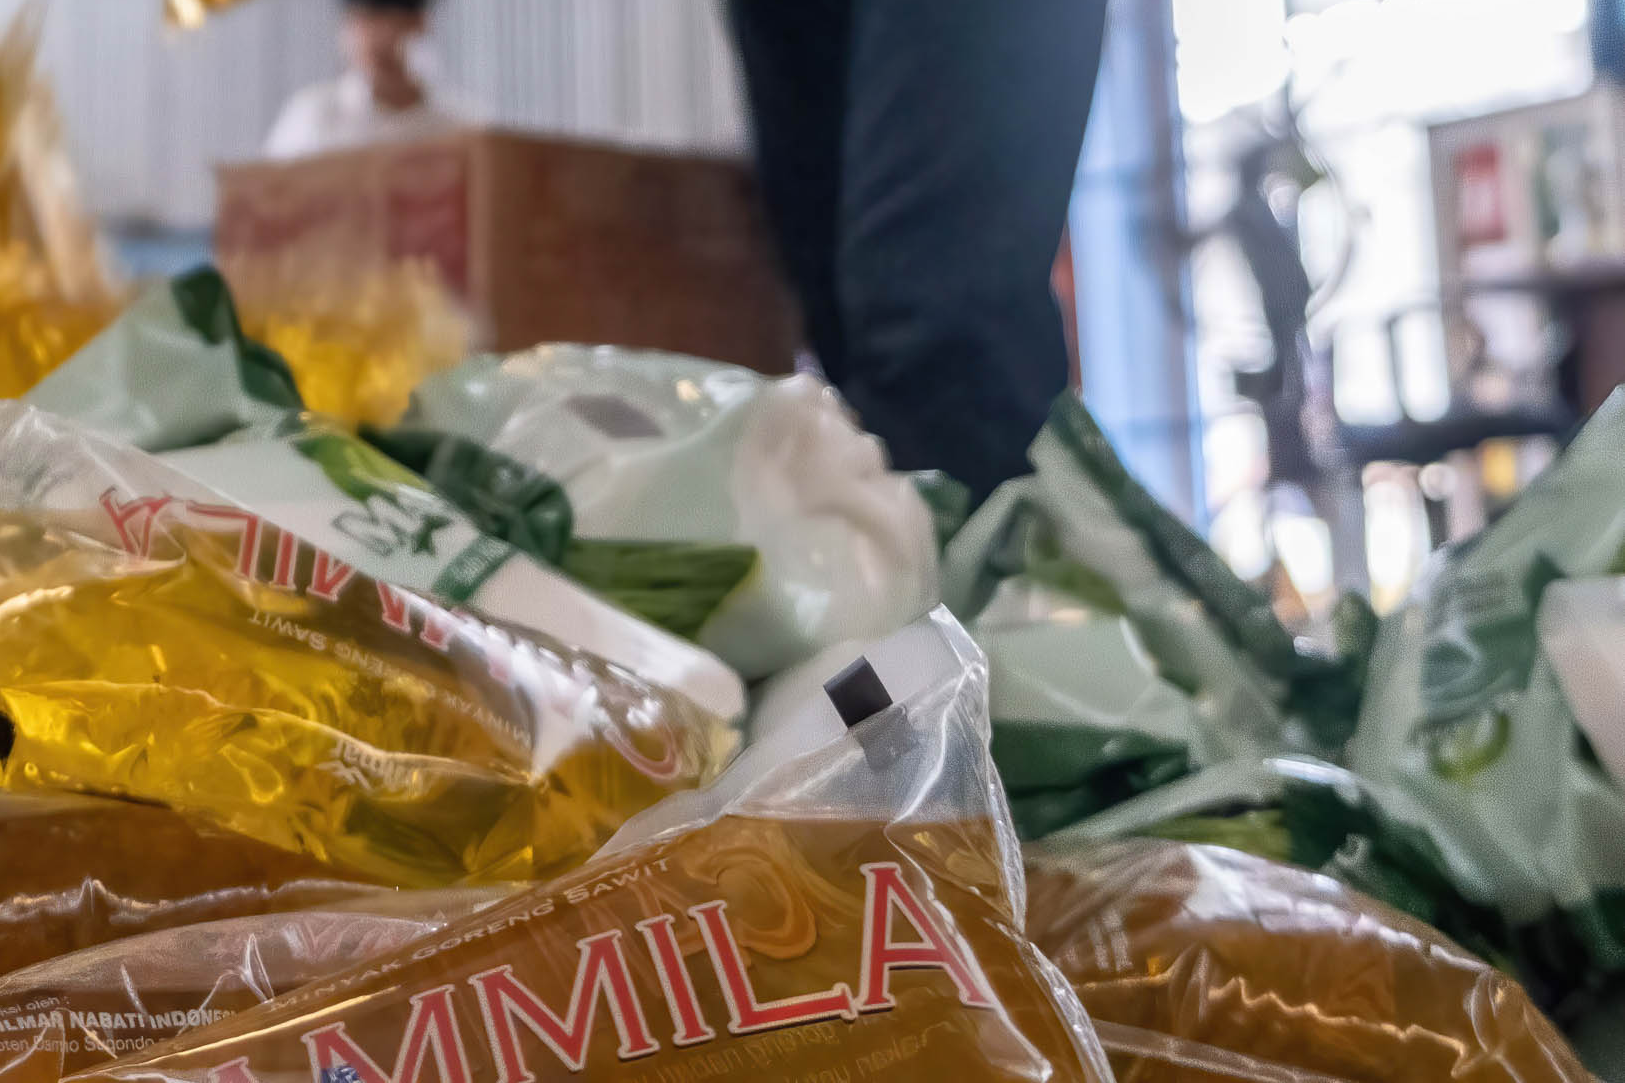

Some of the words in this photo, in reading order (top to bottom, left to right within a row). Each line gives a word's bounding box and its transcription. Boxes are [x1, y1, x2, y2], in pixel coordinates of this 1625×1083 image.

[249, 609, 328, 651] SAWIT
[269, 957, 401, 1011] MINYAK
[412, 897, 555, 961] GORENG
[562, 856, 672, 906] SAWIT
[69, 1010, 146, 1030] NABATI
